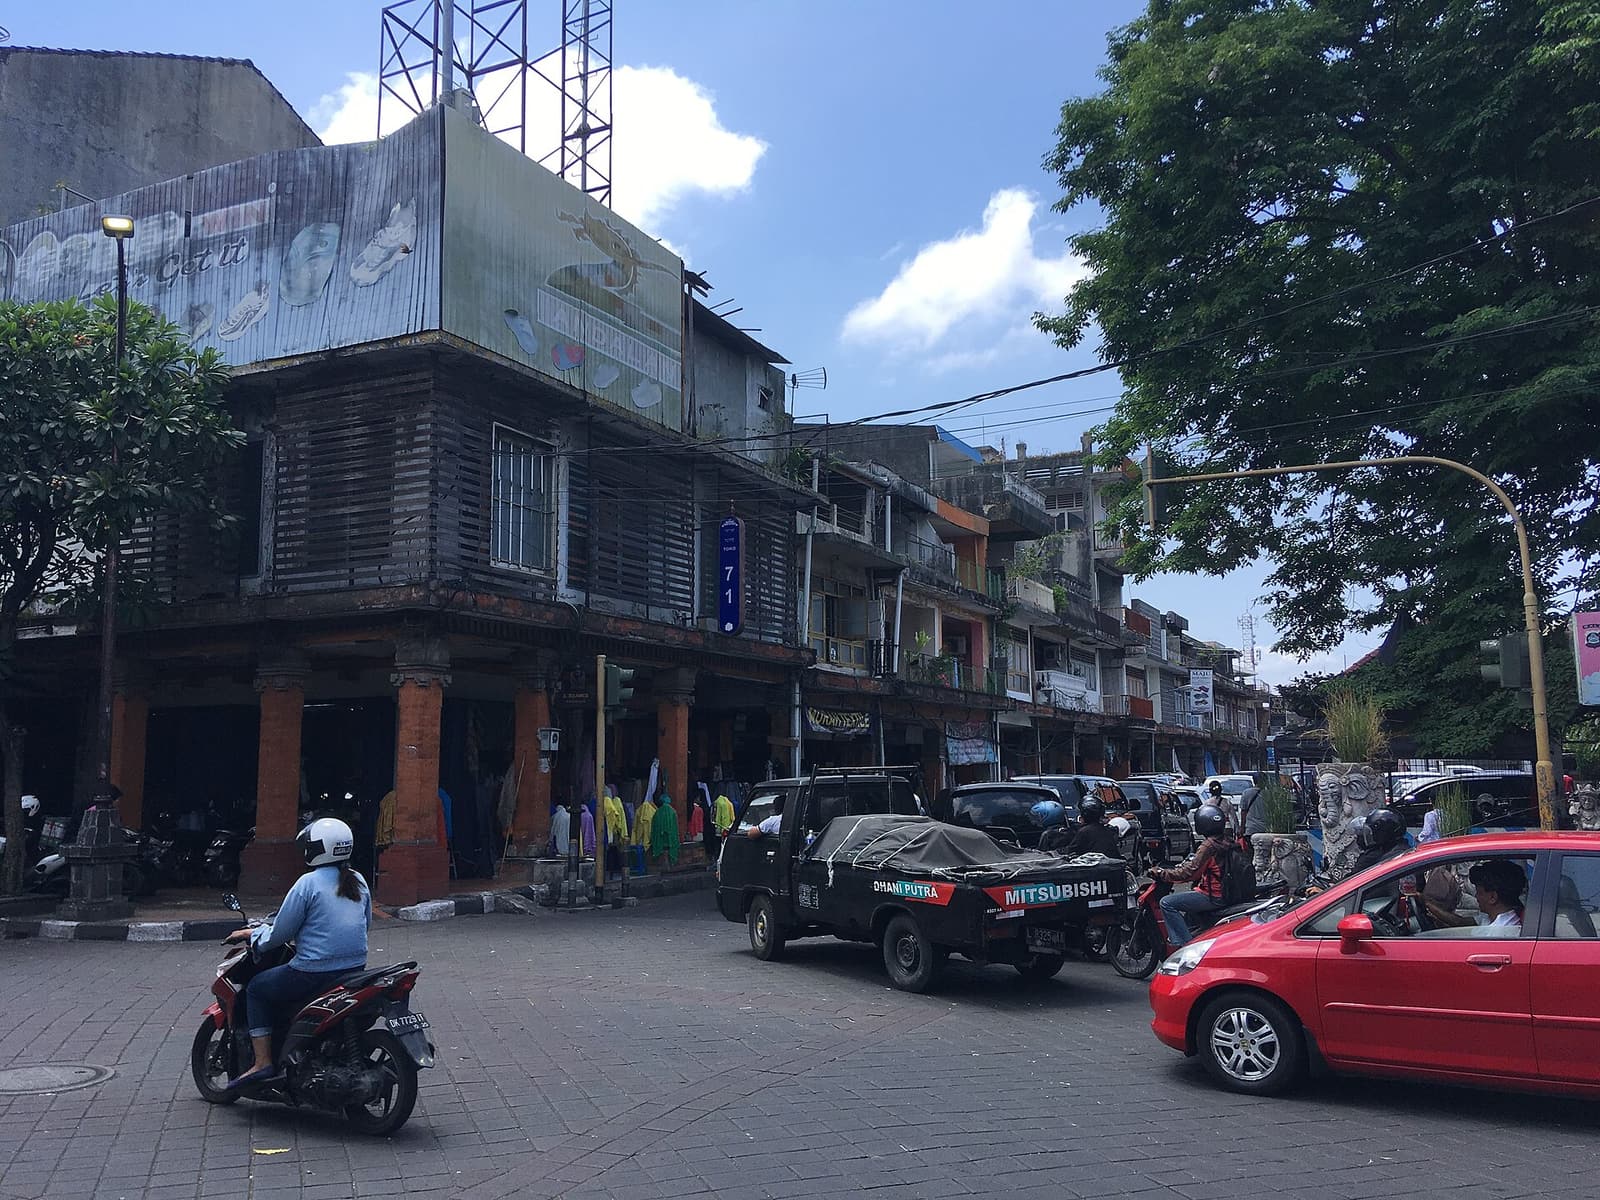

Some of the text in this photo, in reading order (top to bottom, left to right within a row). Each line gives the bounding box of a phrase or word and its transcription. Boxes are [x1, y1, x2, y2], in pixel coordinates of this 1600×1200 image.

[156, 248, 213, 289] Get
[218, 236, 248, 268] It
[904, 884, 939, 899] PUTRA
[1005, 880, 1108, 906] MITSUBISHI
[389, 1018, 401, 1028] DK
